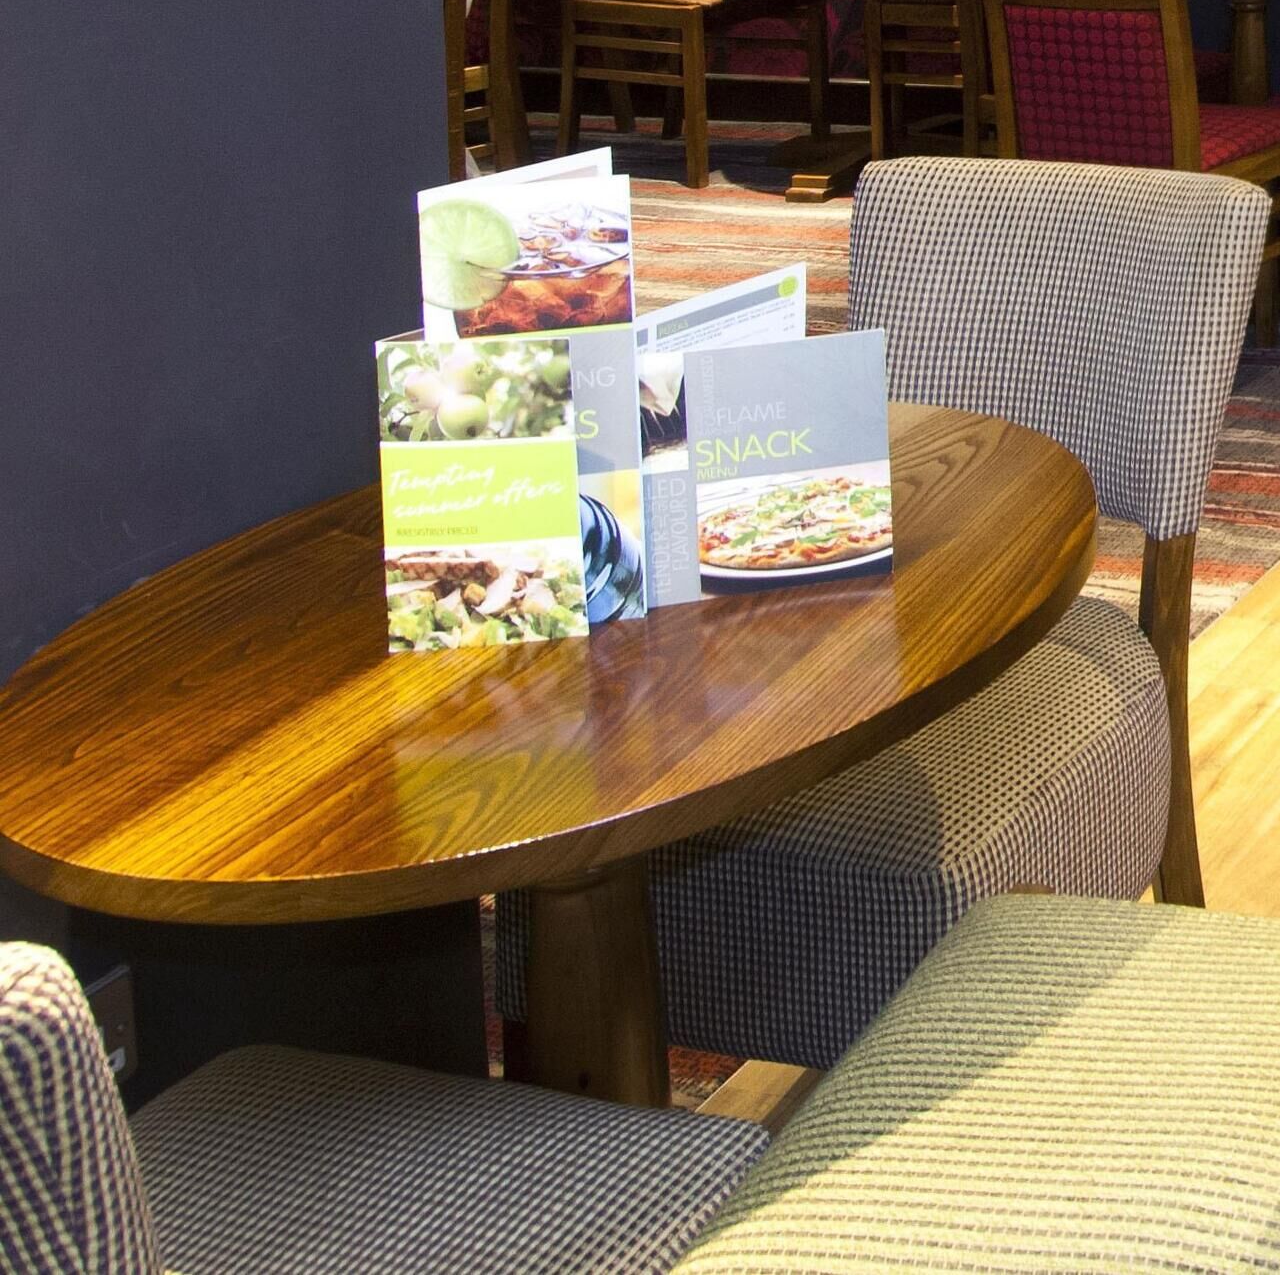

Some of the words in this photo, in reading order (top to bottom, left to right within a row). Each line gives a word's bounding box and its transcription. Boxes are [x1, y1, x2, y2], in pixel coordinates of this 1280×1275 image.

[716, 401, 787, 426] FLAME
[696, 427, 813, 468] SNACK
[389, 463, 496, 496] Tempting
[697, 467, 738, 482] MENU
[393, 494, 486, 519] summer
[493, 476, 566, 508] offers
[669, 499, 690, 571] FLAVOUR
